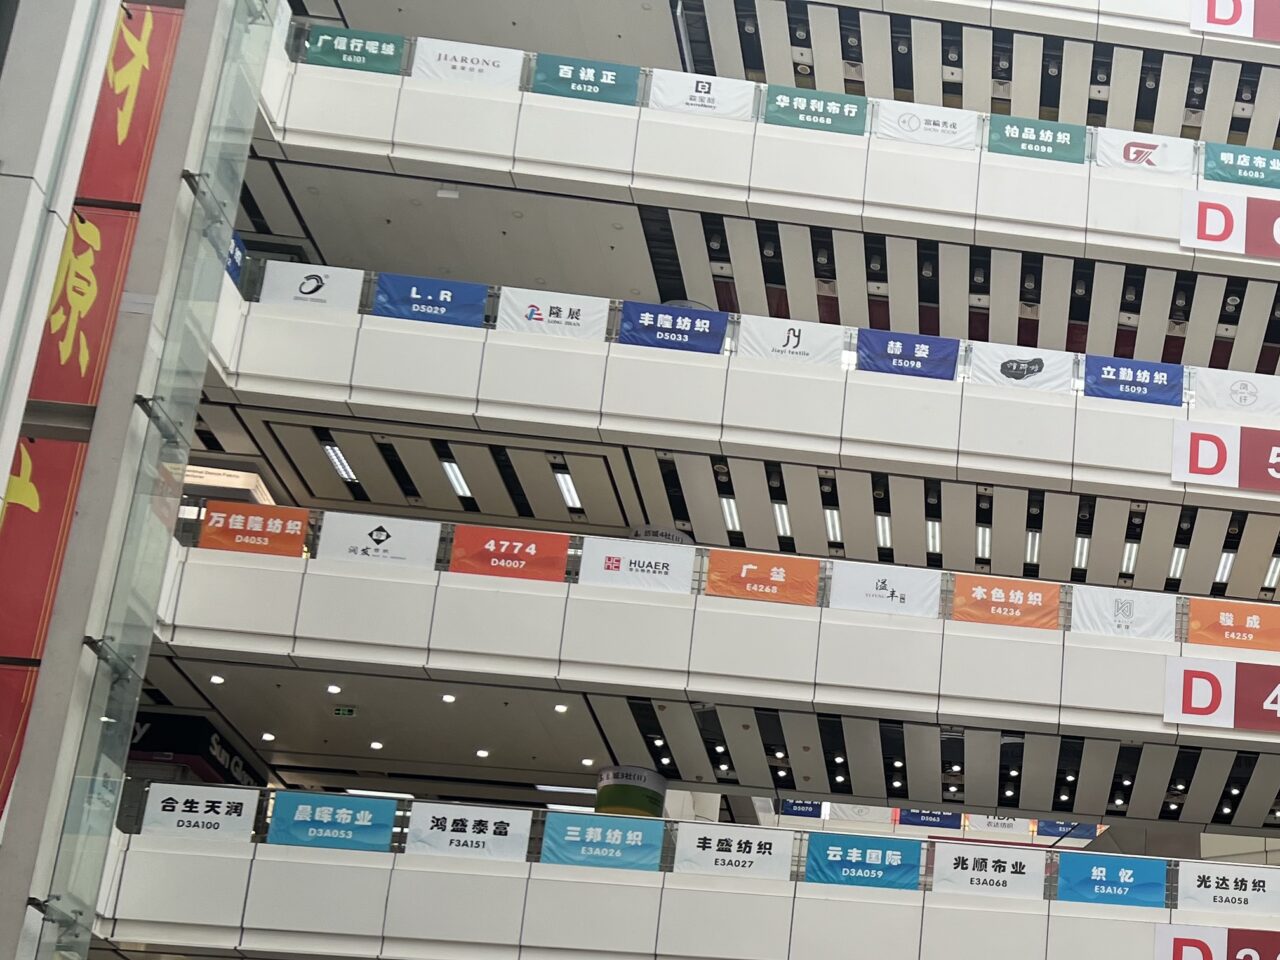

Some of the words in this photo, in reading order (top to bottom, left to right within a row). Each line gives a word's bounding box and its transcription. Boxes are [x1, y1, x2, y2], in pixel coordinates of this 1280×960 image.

[436, 52, 502, 70] JIARONG
[570, 83, 600, 93] E6120
[775, 95, 859, 118] 华得利布行
[1196, 202, 1235, 242] D
[548, 305, 582, 322] 隆展
[638, 313, 710, 333] 丰隆纺织
[656, 331, 689, 343] D5033
[892, 358, 922, 369] E5098
[1101, 366, 1168, 385] 立勤纺织
[1119, 384, 1147, 395] E5093
[1188, 432, 1228, 475] D
[208, 512, 302, 536] 万佳隆纺织
[235, 534, 269, 546] D4053
[484, 538, 537, 556] 4774
[490, 558, 526, 569] D4007
[629, 559, 670, 571] HUAER
[971, 585, 1043, 606] 本色纺织
[990, 606, 1021, 618] E4236
[1224, 630, 1254, 642] E4259
[1181, 669, 1222, 716] D
[160, 796, 244, 817] 合生天润
[293, 805, 373, 826] 晨晖布业
[176, 819, 220, 831] D3A100
[430, 816, 510, 837] 鸿盛泰富
[563, 825, 643, 847] 三邦纺织
[696, 836, 773, 857] 丰盛纺织
[713, 857, 754, 869] E3A027
[826, 846, 903, 867] 云丰国际
[953, 856, 1026, 875] 兆顺布业
[969, 877, 1008, 888] E3A068
[1094, 885, 1129, 896] E3A167
[1196, 874, 1267, 893] 光达纺织
[1212, 895, 1249, 906] E3A058
